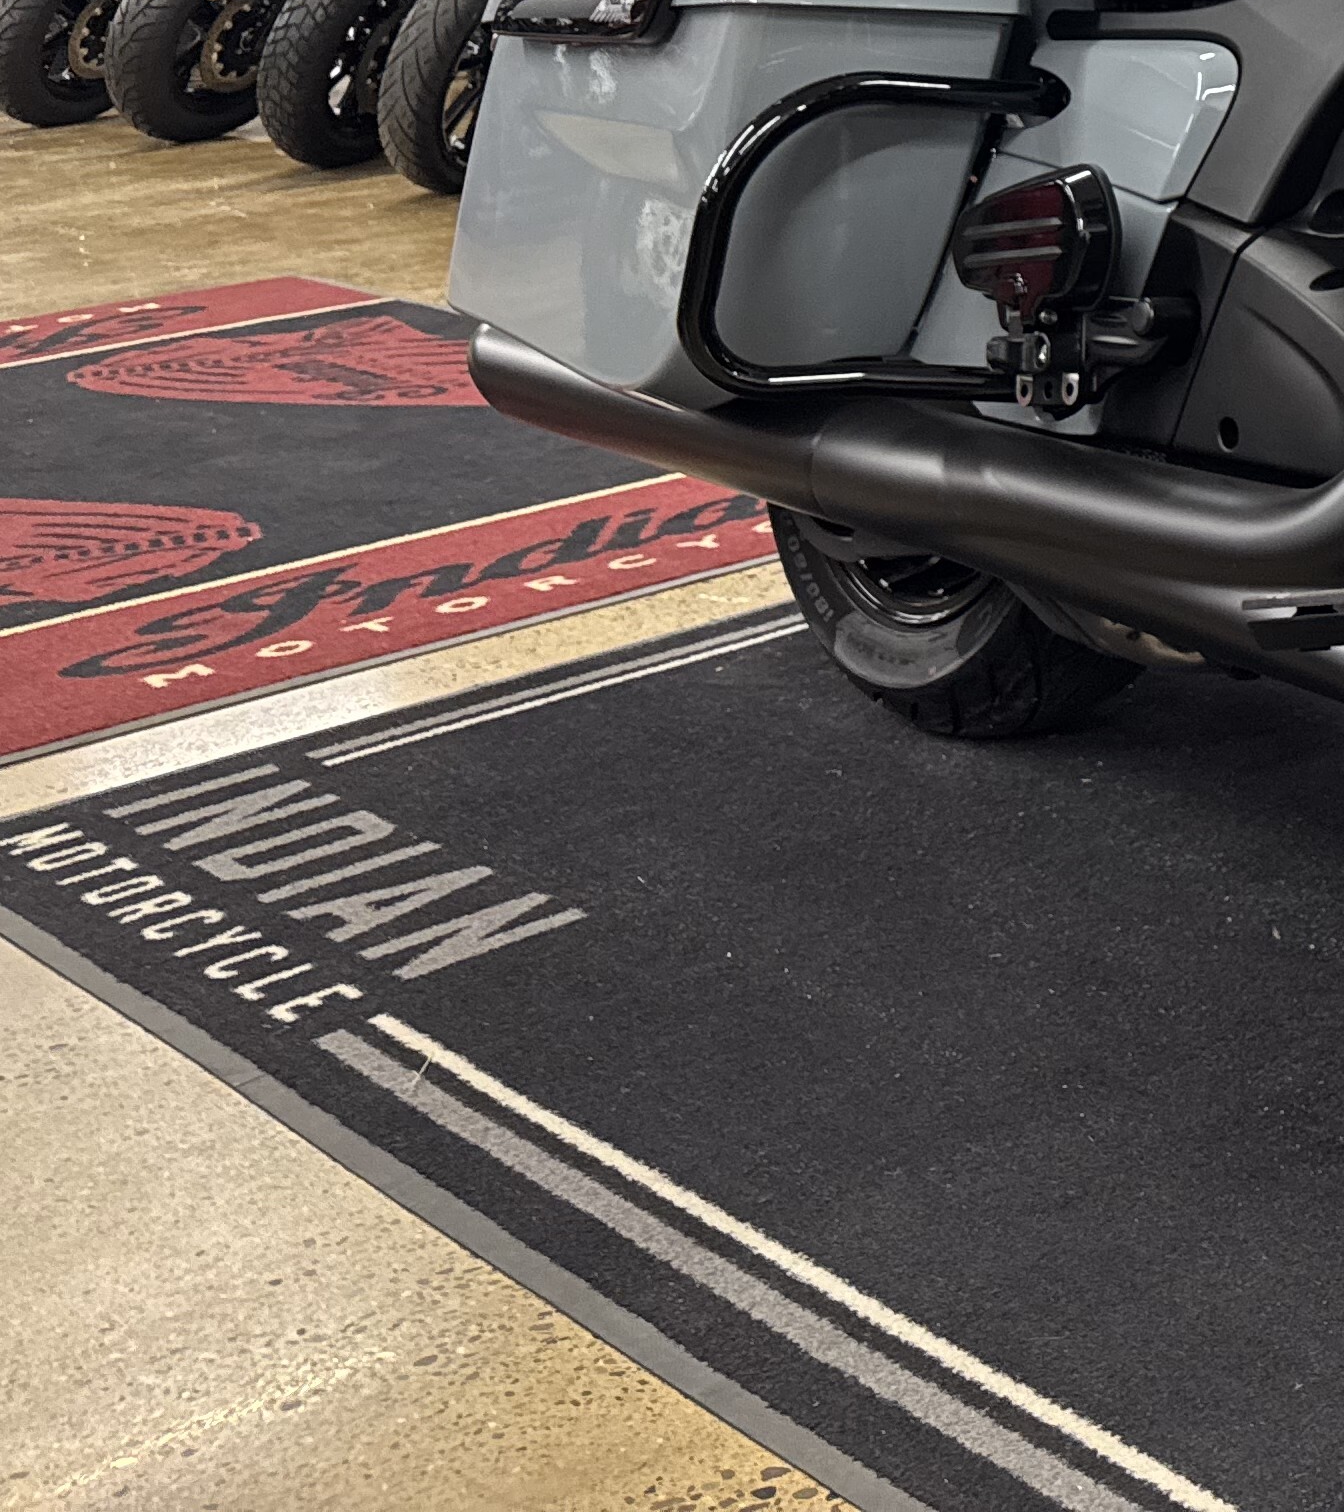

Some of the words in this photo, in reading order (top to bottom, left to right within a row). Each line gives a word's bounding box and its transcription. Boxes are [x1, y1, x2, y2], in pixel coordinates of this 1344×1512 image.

[59, 494, 768, 678] India
[0, 822, 363, 1024] MOTORCYCLE
[103, 764, 588, 982] INDIAN
